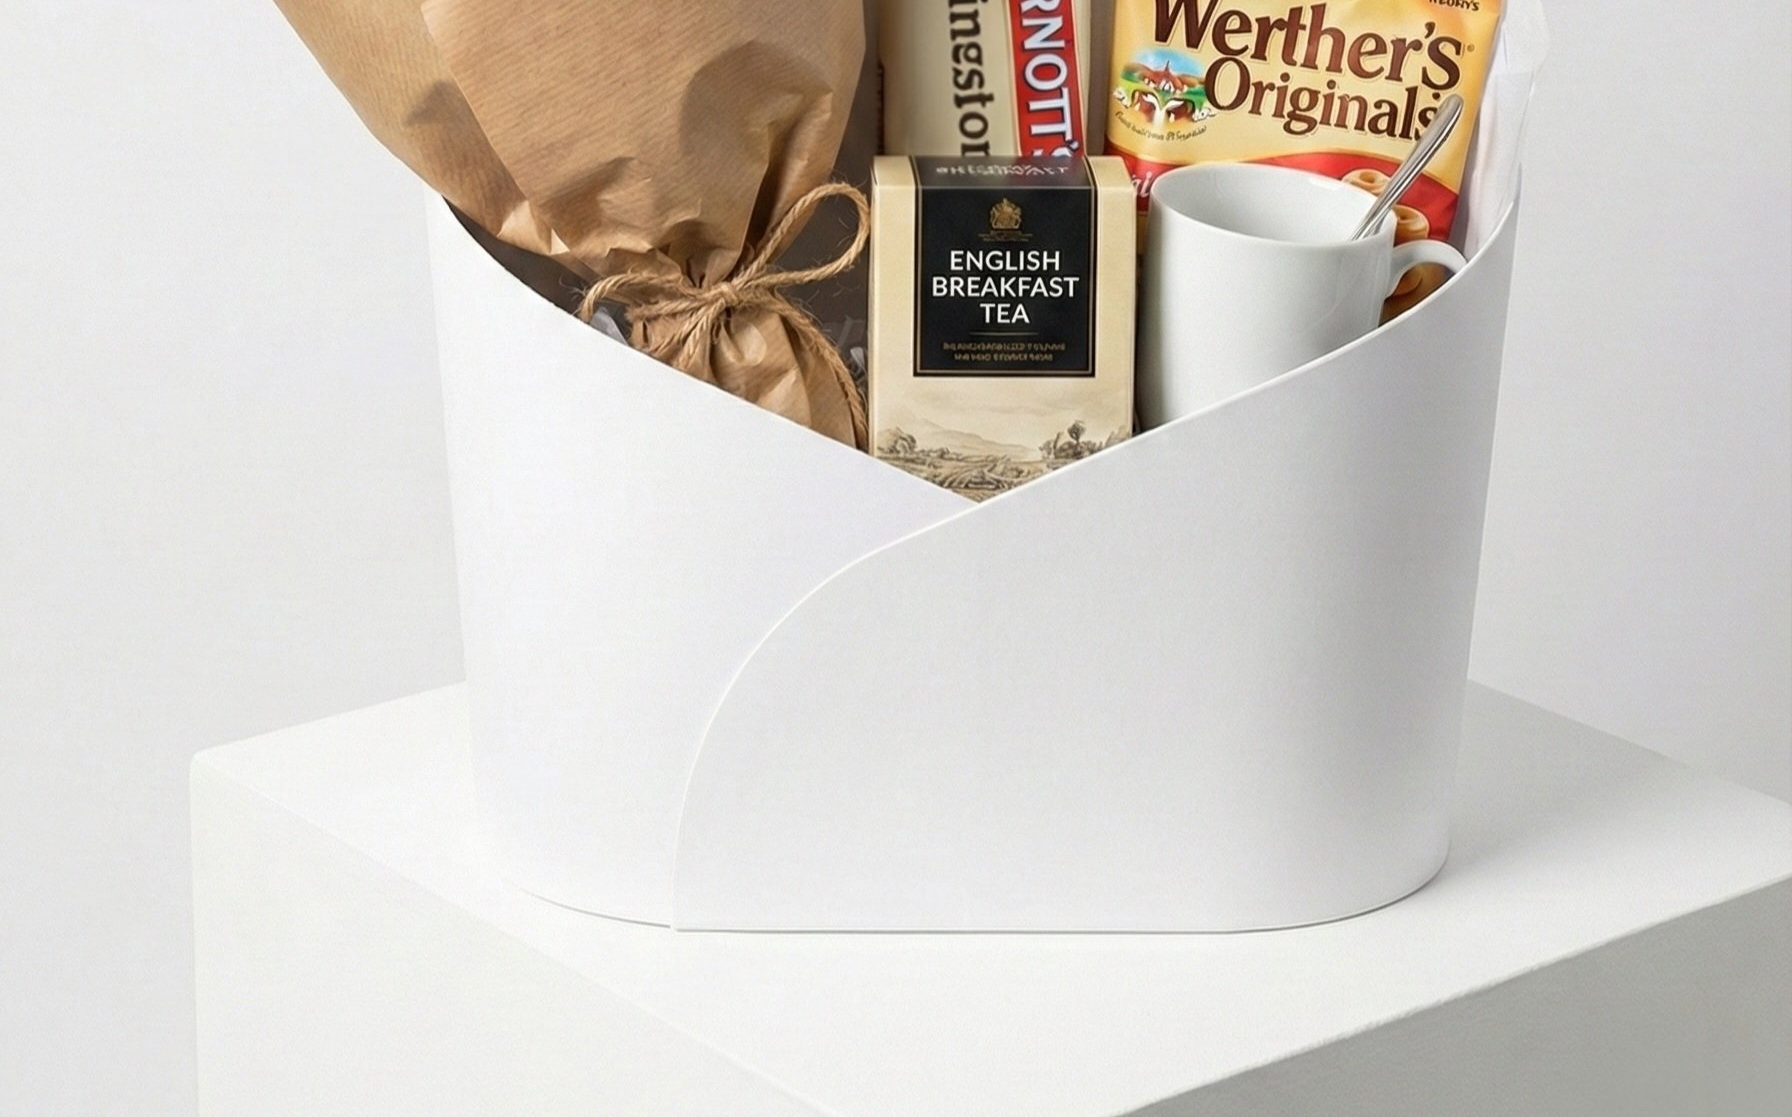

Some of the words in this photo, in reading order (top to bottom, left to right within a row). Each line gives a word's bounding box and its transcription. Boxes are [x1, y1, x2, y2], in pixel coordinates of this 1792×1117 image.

[950, 250, 1060, 271] ENGLISH
[932, 276, 1080, 298] BREAKFAST
[979, 303, 1030, 324] TEA
